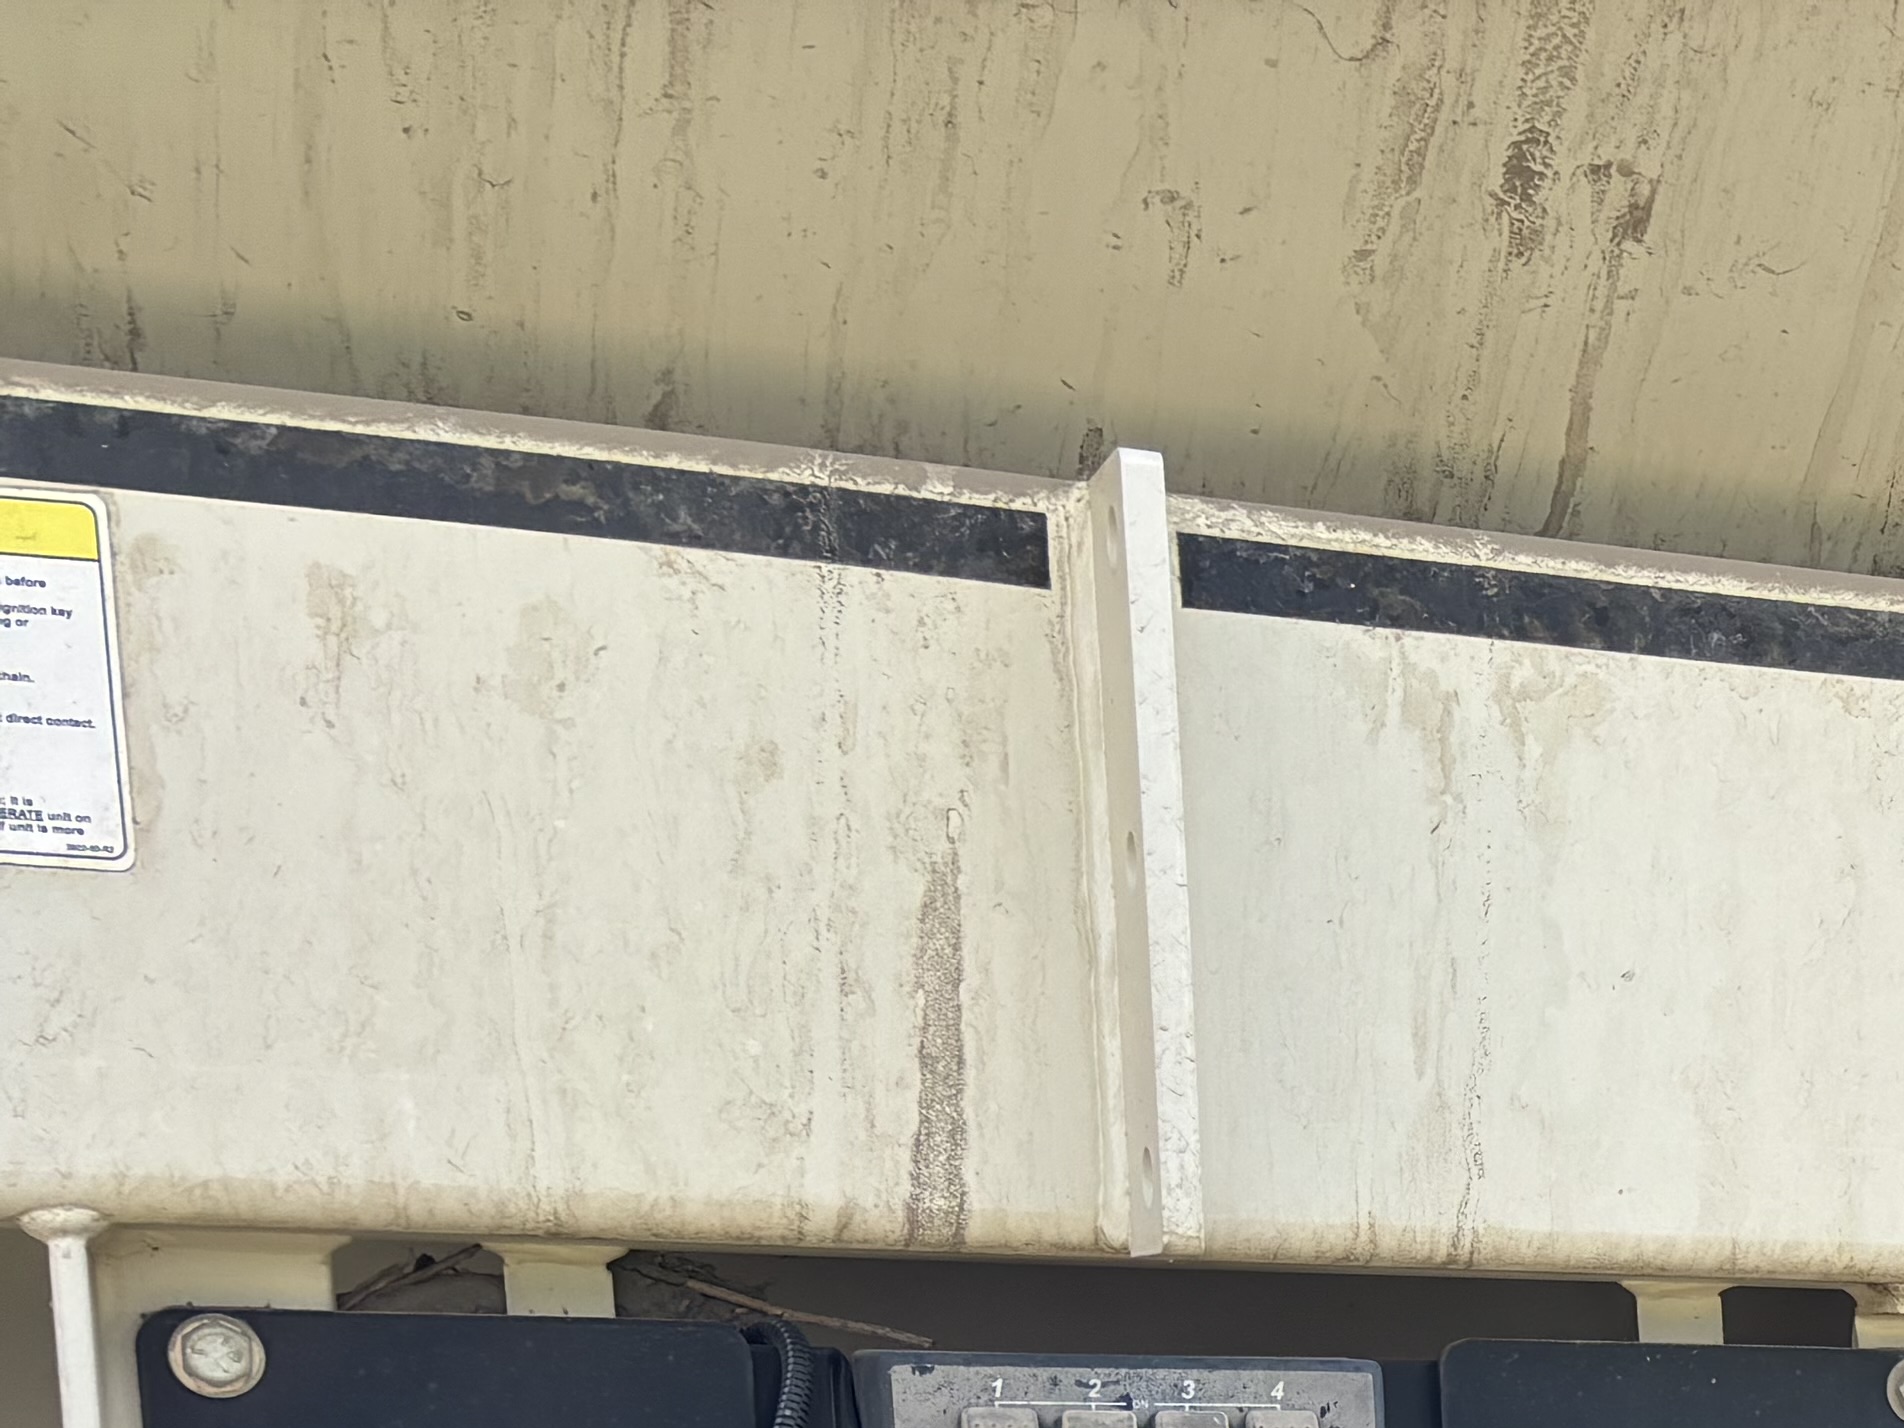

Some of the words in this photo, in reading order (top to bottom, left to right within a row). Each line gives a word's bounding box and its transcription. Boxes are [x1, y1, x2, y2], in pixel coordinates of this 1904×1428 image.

[5, 576, 46, 588] before
[0, 604, 47, 616] gnition
[51, 606, 73, 619] key
[6, 713, 43, 726] direct
[75, 814, 92, 823] on
[990, 1380, 1004, 1399] 1
[1088, 1380, 1102, 1399] 2
[1181, 1381, 1196, 1400] 3
[1270, 1381, 1285, 1400] 4
